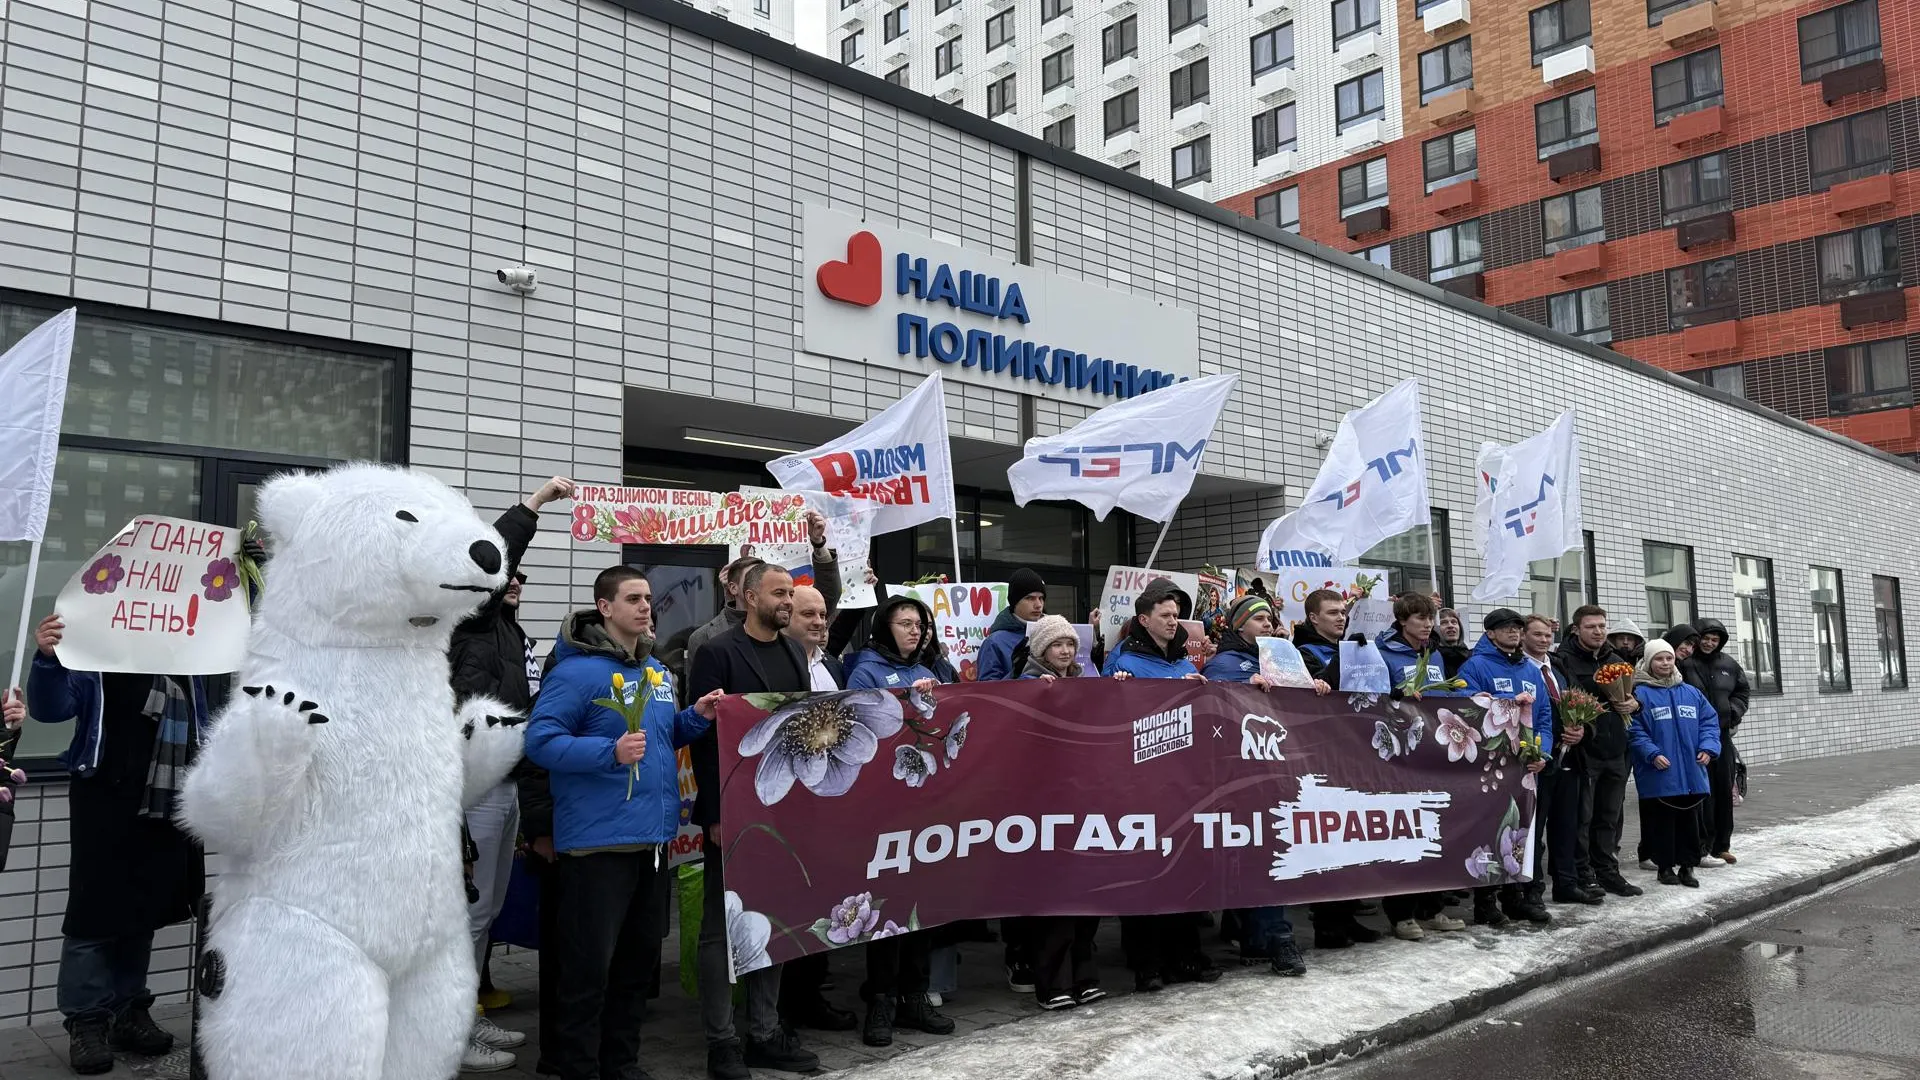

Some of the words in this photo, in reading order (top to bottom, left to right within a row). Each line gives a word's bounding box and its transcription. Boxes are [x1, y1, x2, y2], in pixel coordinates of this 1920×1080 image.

[897, 252, 1030, 324] НАША
[897, 312, 1190, 399] ПОЛИКЛИНИК
[582, 486, 668, 505] ПРАЗДНИКОМ
[107, 520, 225, 559] ЕГОДНЯ
[571, 503, 598, 541] 8
[749, 521, 808, 544] ДАМЫ!
[125, 559, 184, 594] НАШ
[1112, 571, 1172, 591] БУК
[110, 593, 200, 637] ДЕНЬ!
[1137, 736, 1190, 761] ПОДМОСКОВЬЕ
[866, 813, 1174, 880] ДОРОГАЯ,
[1193, 811, 1264, 848] ТЫ
[1292, 808, 1424, 846] ПРАВА!
